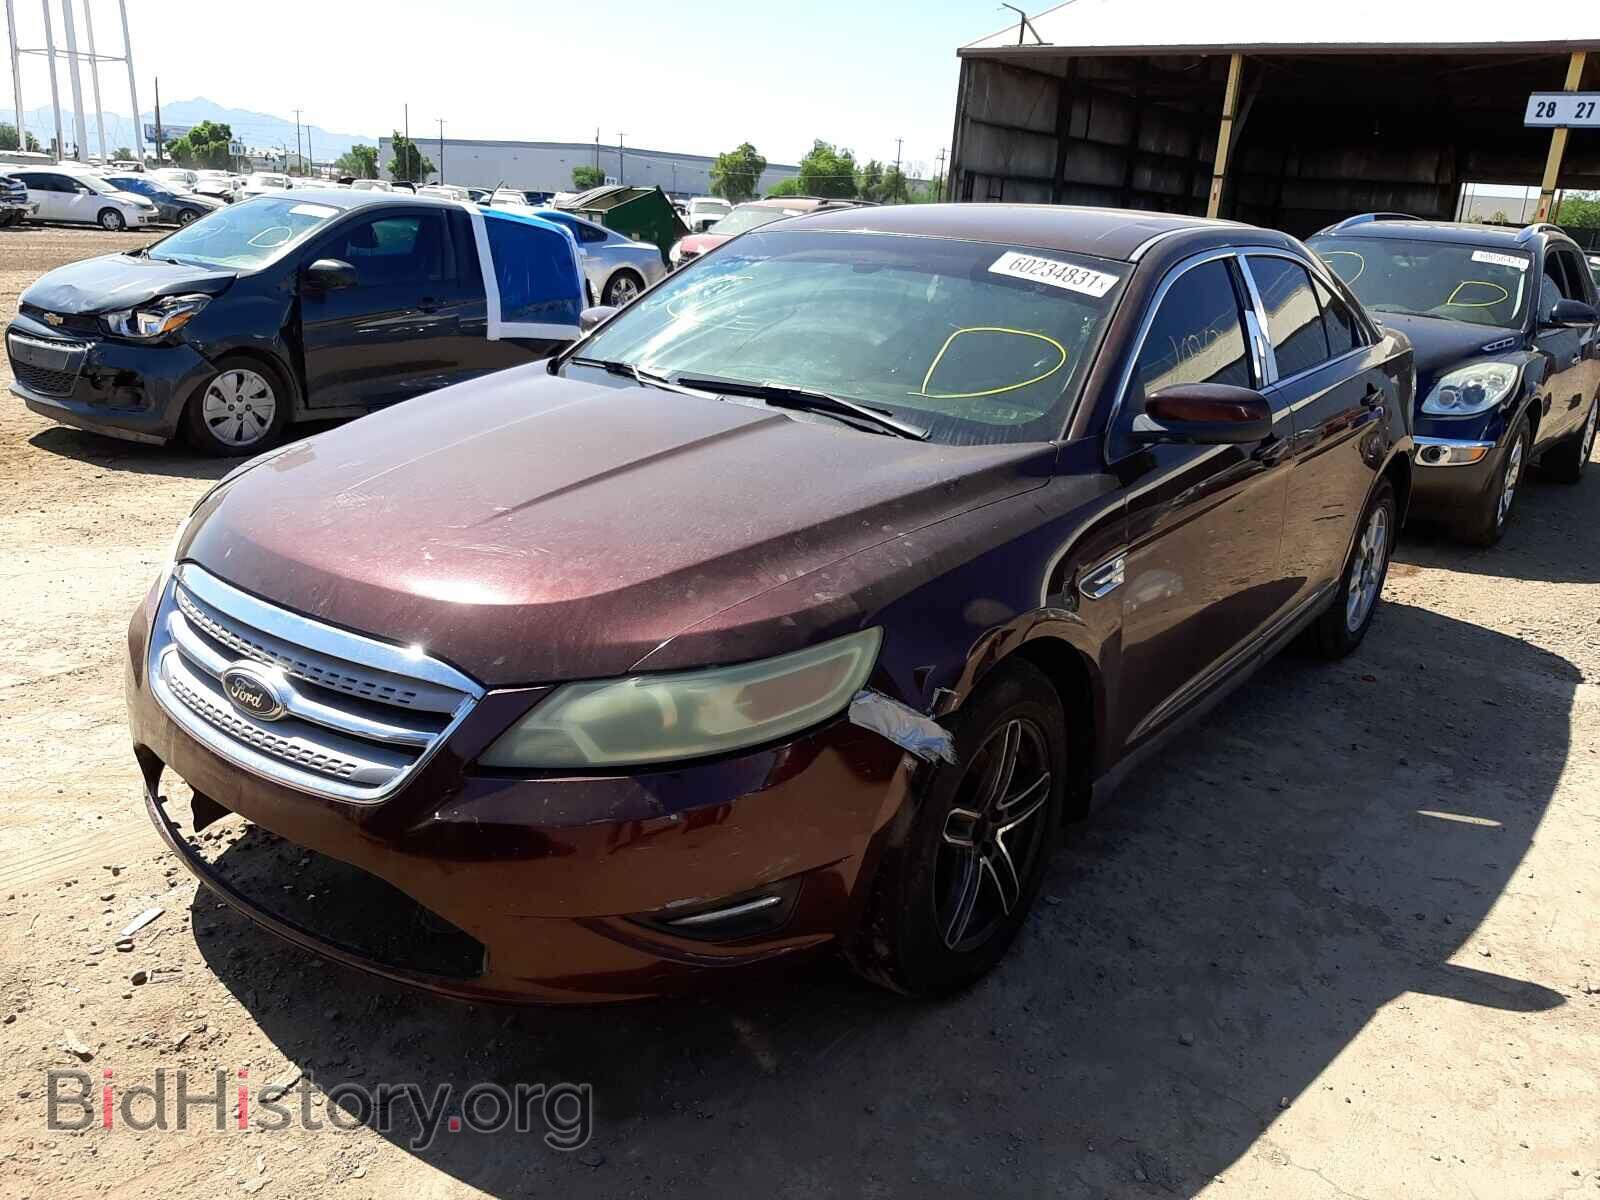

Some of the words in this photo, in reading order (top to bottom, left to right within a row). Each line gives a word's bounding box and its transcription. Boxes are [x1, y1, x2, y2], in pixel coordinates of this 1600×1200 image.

[1535, 101, 1557, 118] 28
[1574, 101, 1596, 119] 27
[231, 677, 264, 708] Ford
